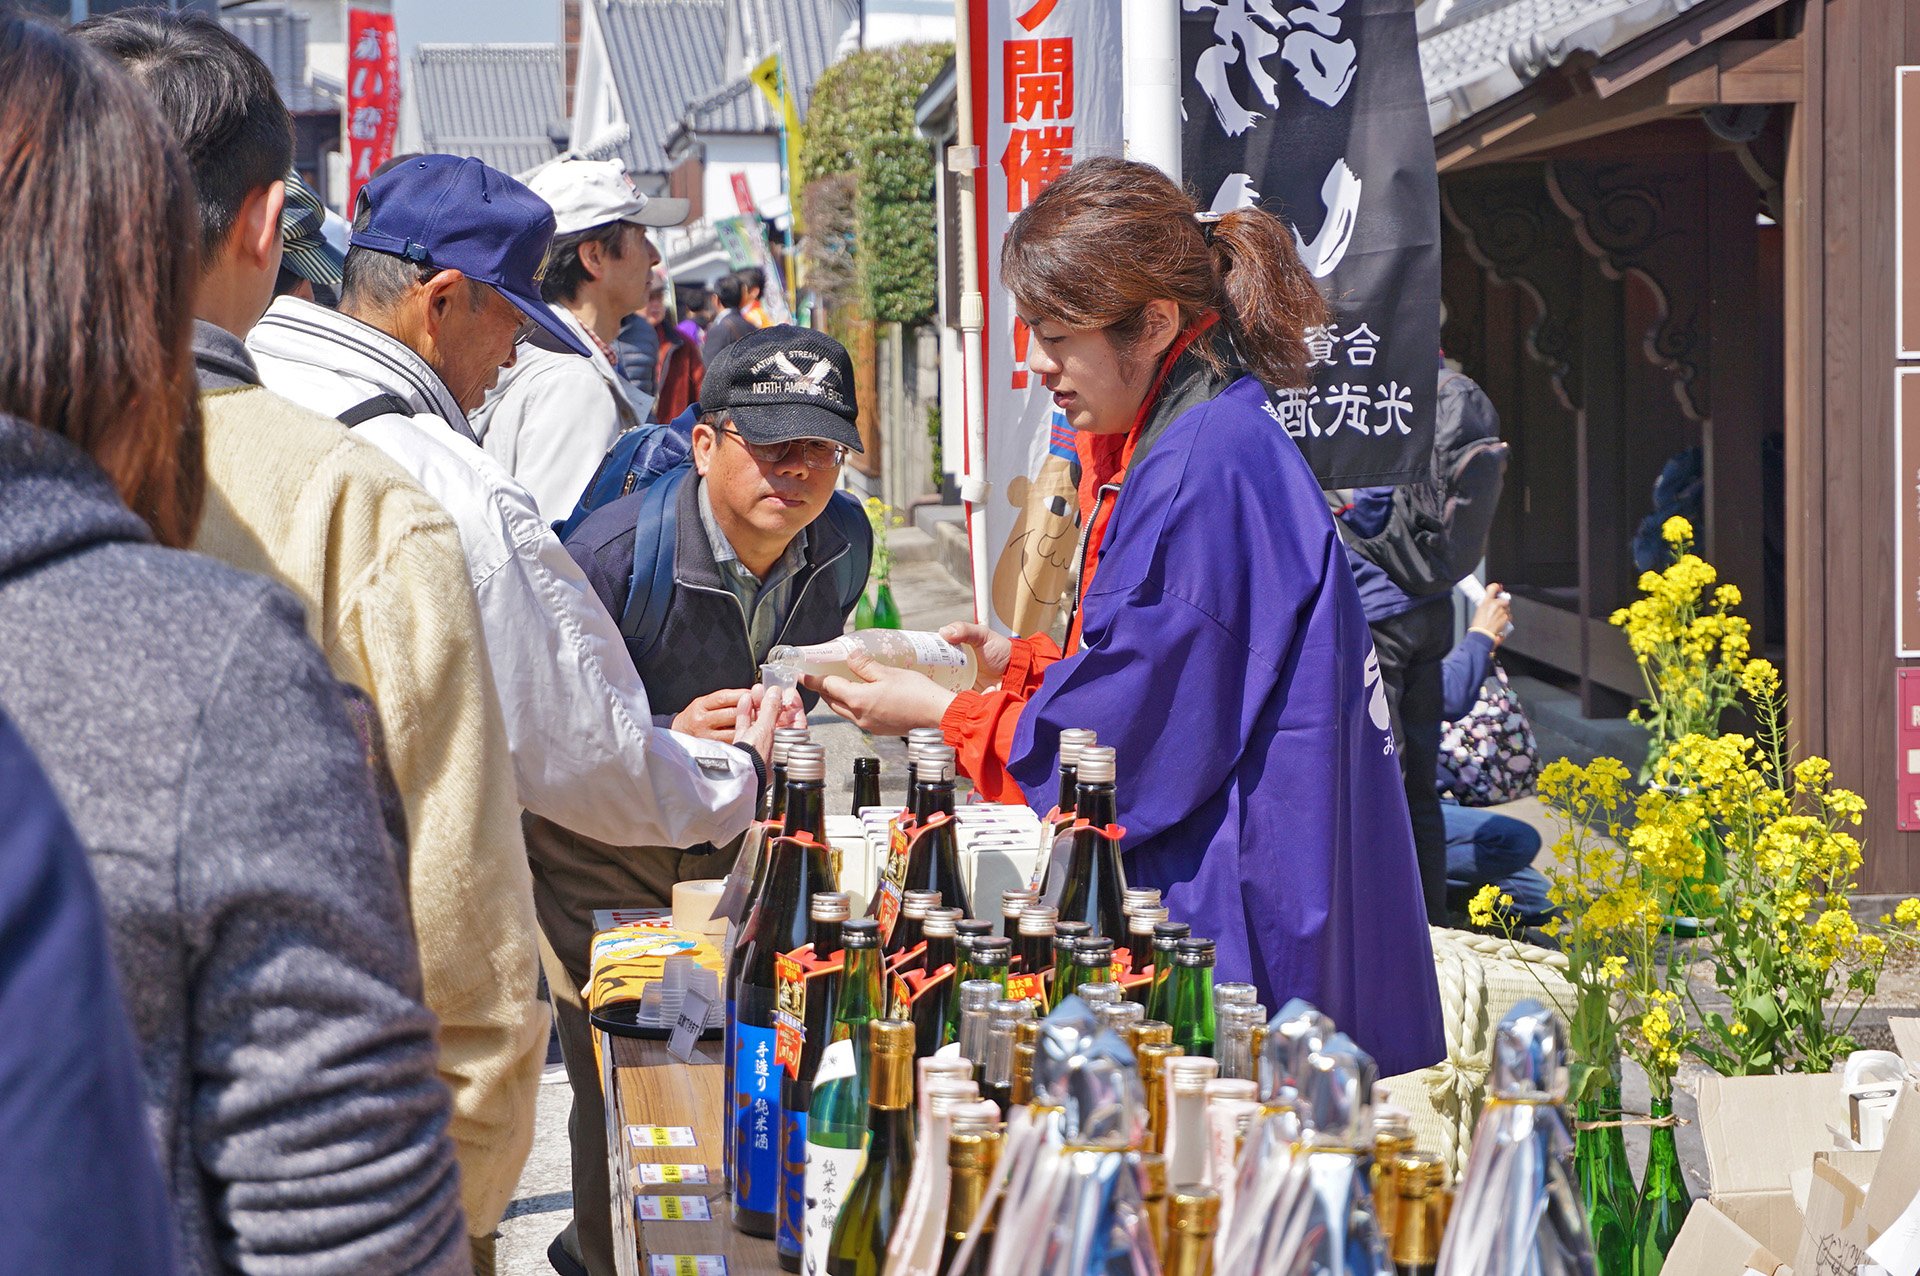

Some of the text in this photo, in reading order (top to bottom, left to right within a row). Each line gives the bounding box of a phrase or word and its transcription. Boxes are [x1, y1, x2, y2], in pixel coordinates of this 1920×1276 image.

[752, 381, 782, 394] NORTH
[1007, 988, 1027, 999] 016
[754, 1041, 770, 1150] 手造り 純米酒
[819, 1159, 838, 1230] 純米吟醸
